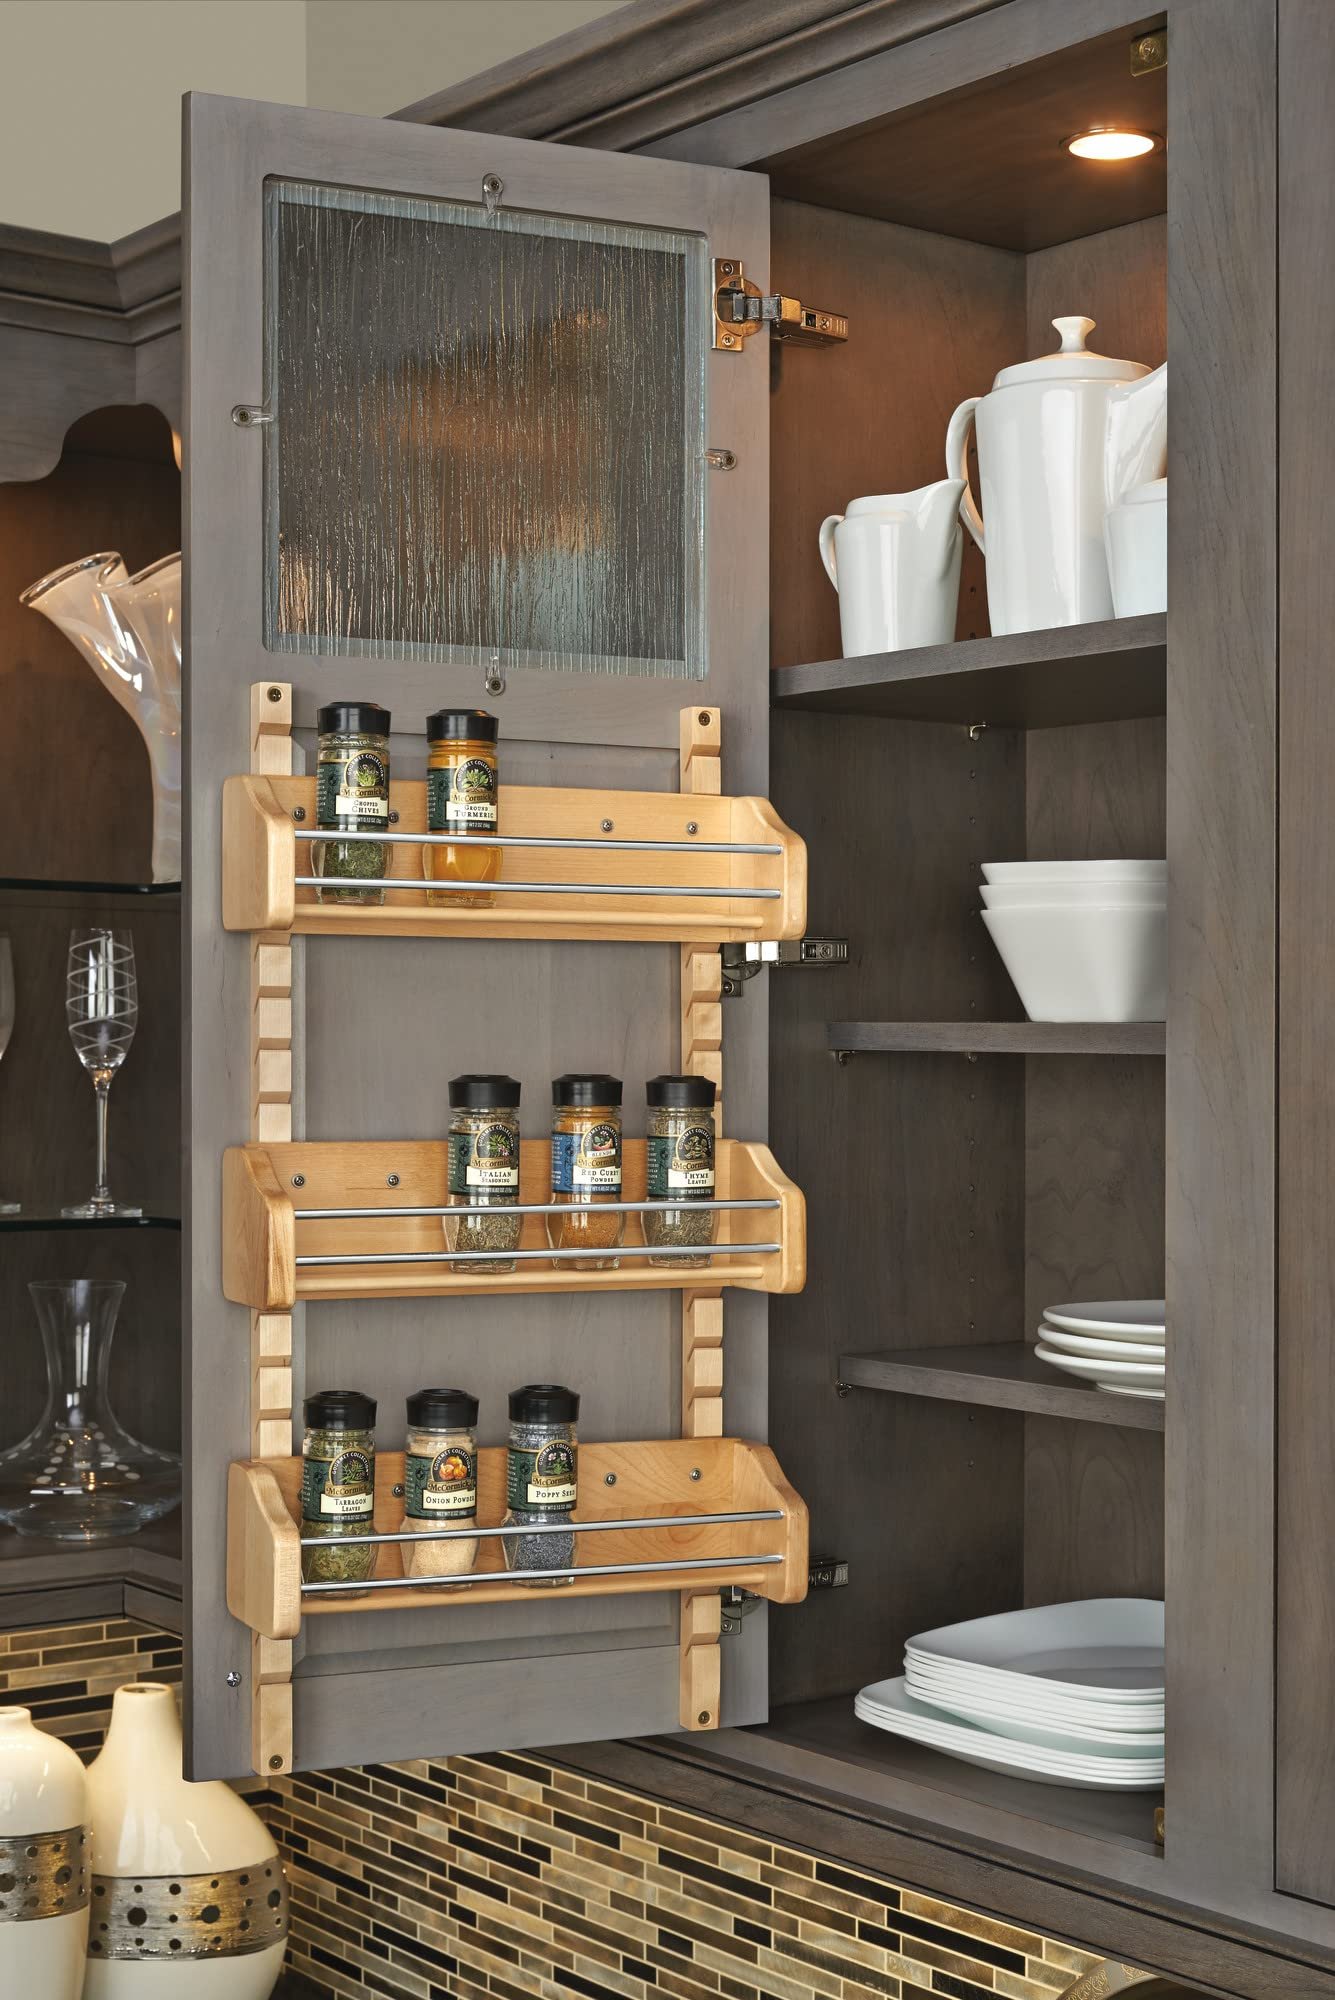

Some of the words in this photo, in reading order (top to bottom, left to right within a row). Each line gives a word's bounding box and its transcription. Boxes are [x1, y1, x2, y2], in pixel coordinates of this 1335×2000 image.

[352, 806, 379, 814] CHIVES
[455, 810, 494, 818] TURMERIC
[426, 1496, 450, 1504] ONION
[453, 1495, 474, 1503] POWDER
